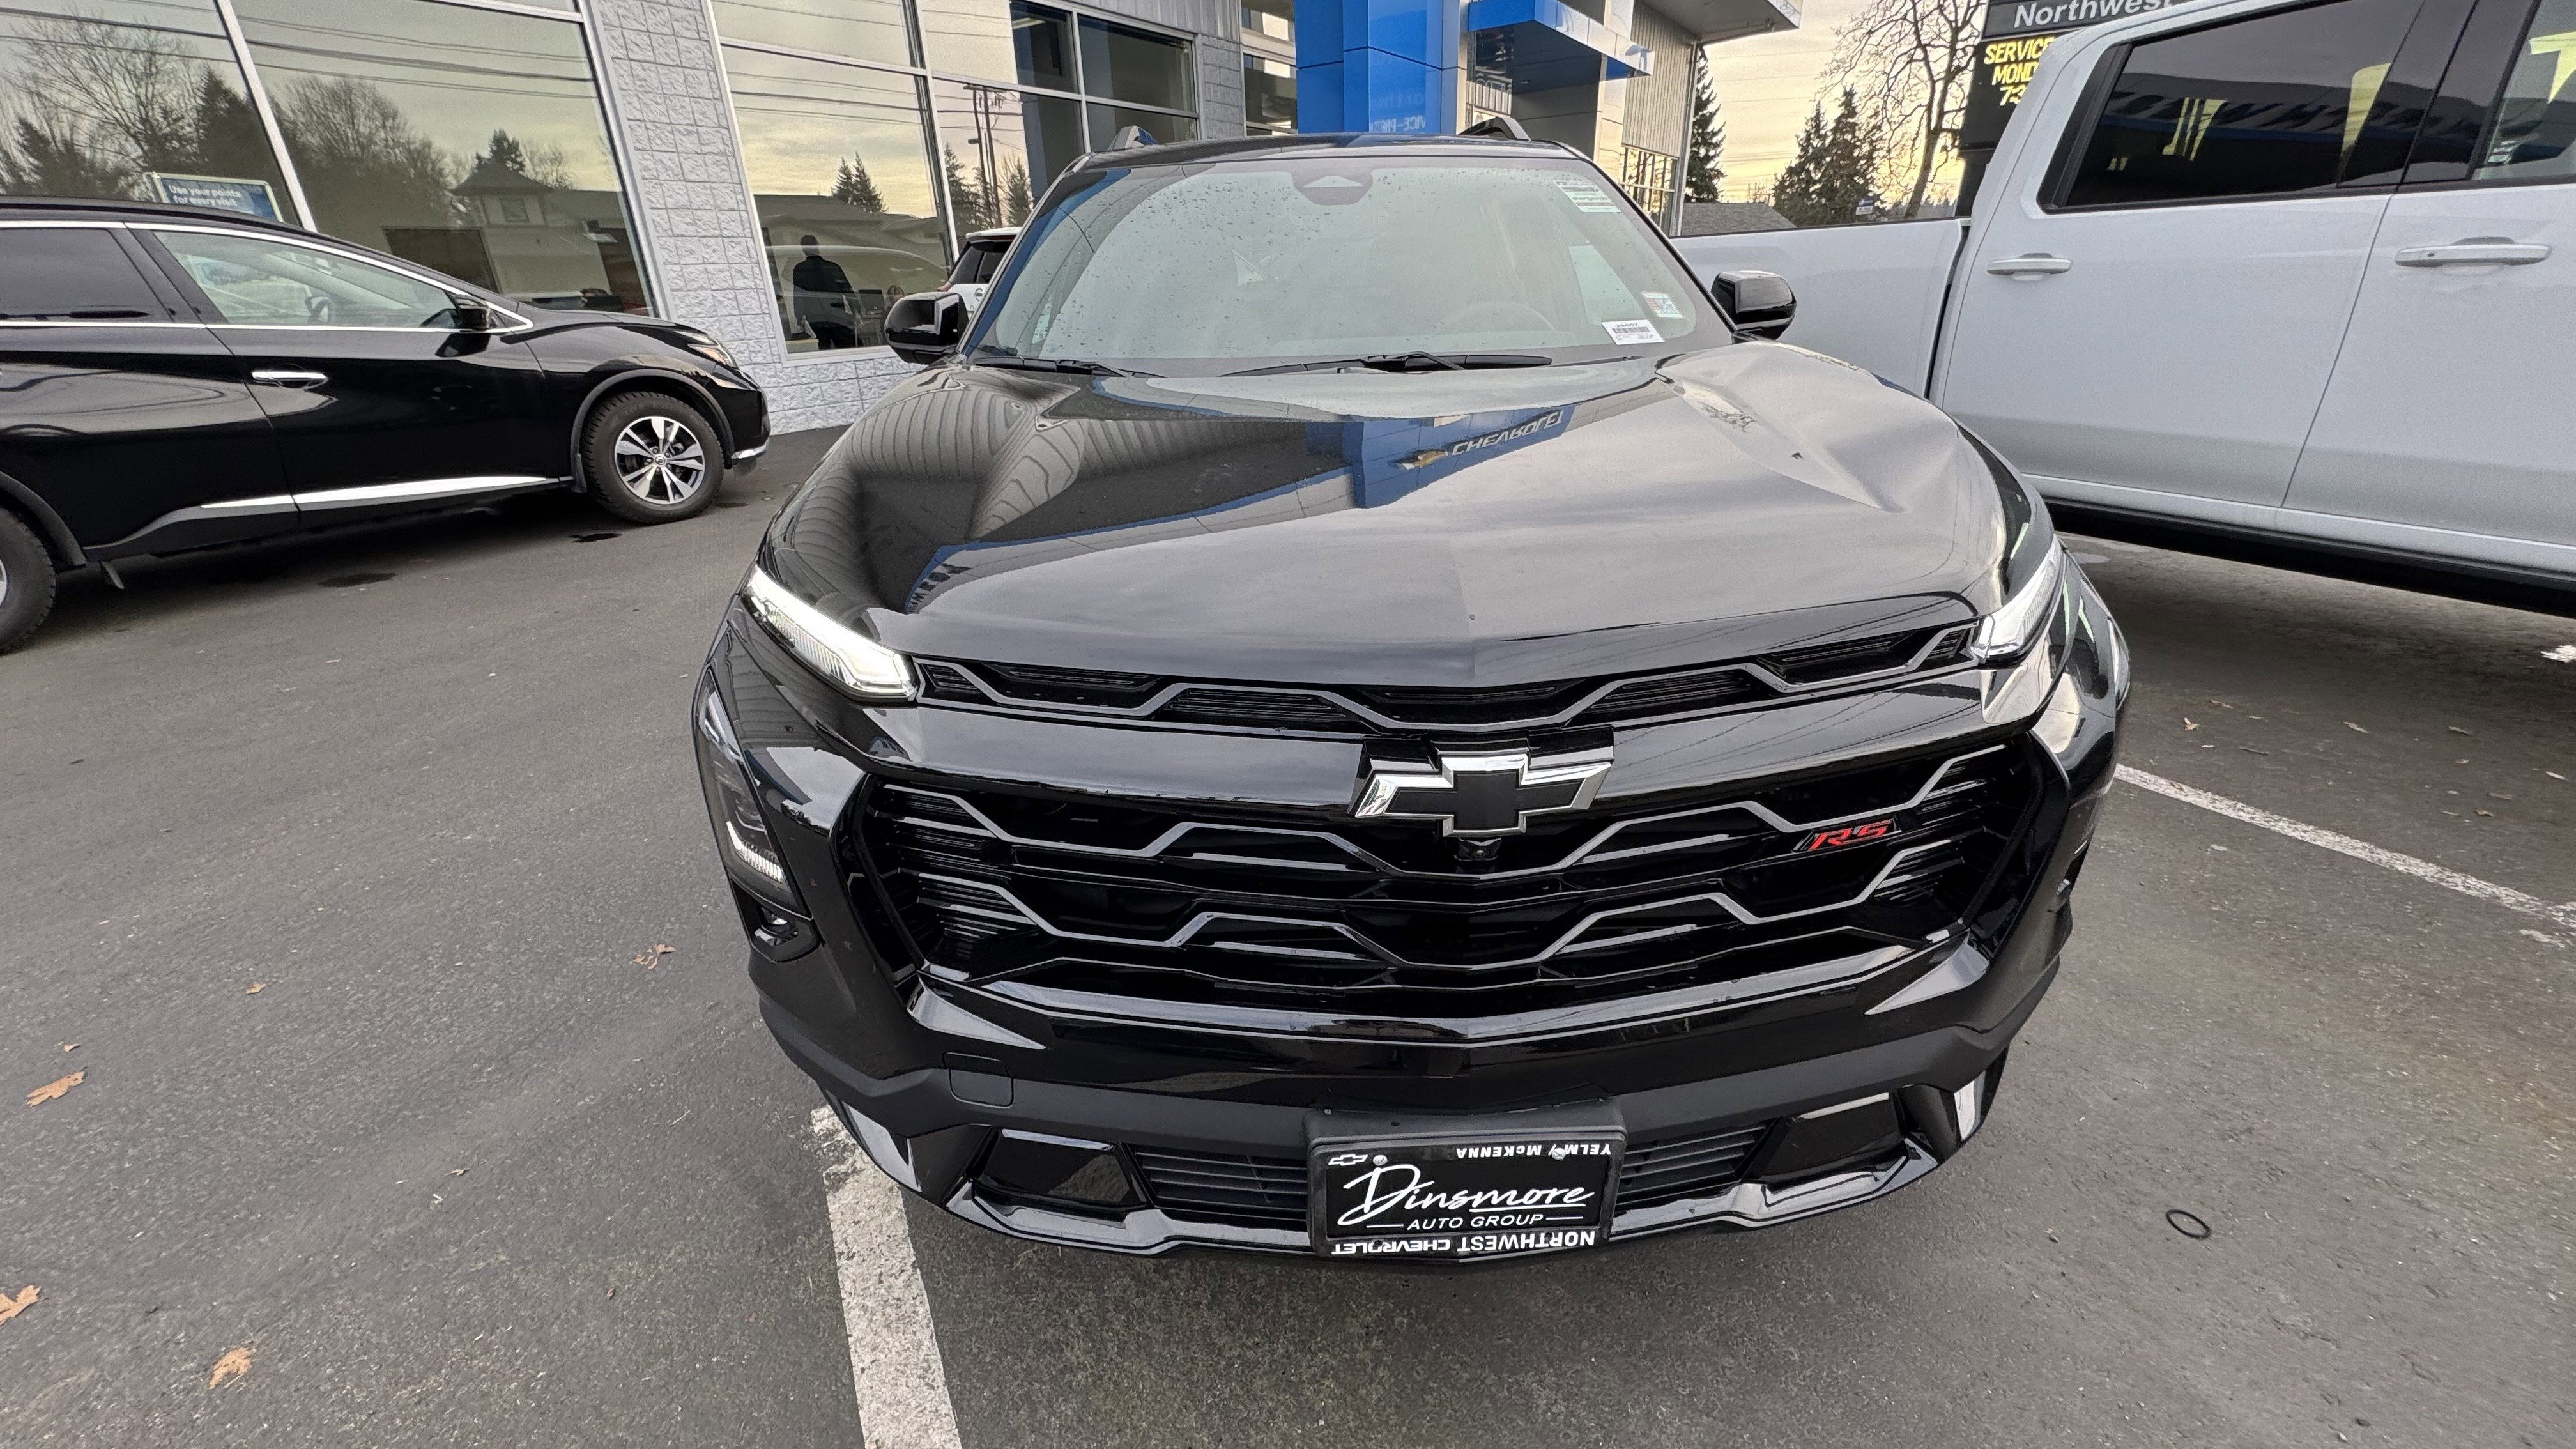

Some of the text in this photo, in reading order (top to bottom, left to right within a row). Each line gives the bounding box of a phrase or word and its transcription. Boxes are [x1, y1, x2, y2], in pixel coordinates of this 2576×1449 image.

[172, 194, 236, 206] for every visit
[190, 188, 210, 197] your
[212, 189, 241, 198] points
[1809, 818, 1894, 850] RS
[1563, 1143, 1611, 1156] YELM
[1337, 1163, 1595, 1226] Dinsmore
[1407, 1213, 1544, 1230] AUTO GROUP
[1331, 1230, 1595, 1255] NORTHWEST CHEVROLET
